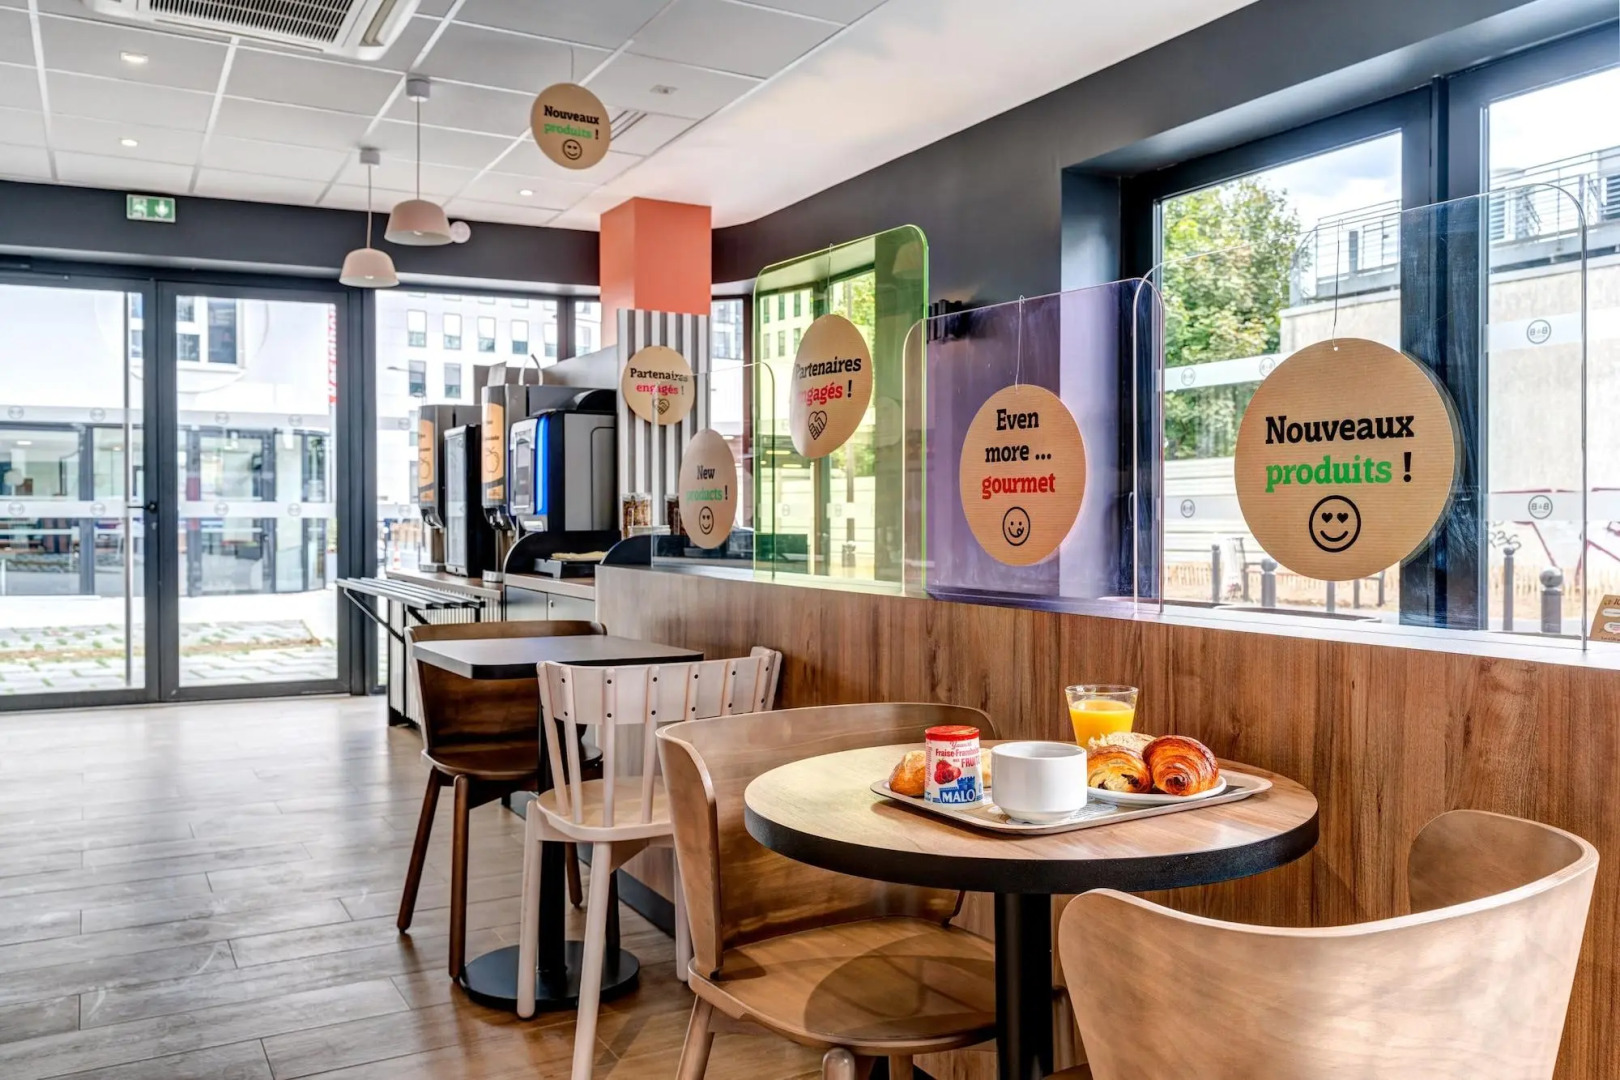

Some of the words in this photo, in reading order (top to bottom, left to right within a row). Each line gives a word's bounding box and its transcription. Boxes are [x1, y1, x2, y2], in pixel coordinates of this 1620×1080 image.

[543, 104, 600, 125] Nouveaux
[543, 123, 593, 139] produits
[594, 128, 599, 140] !
[846, 379, 852, 398] !
[996, 408, 1039, 431] Even
[1265, 415, 1415, 444] Nouveaux
[985, 445, 1029, 463] more
[696, 465, 716, 480] New
[1265, 454, 1392, 493] produits
[1403, 451, 1412, 482] !
[724, 484, 728, 500] !
[982, 473, 1056, 499] gourmet
[941, 788, 976, 803] MALO
